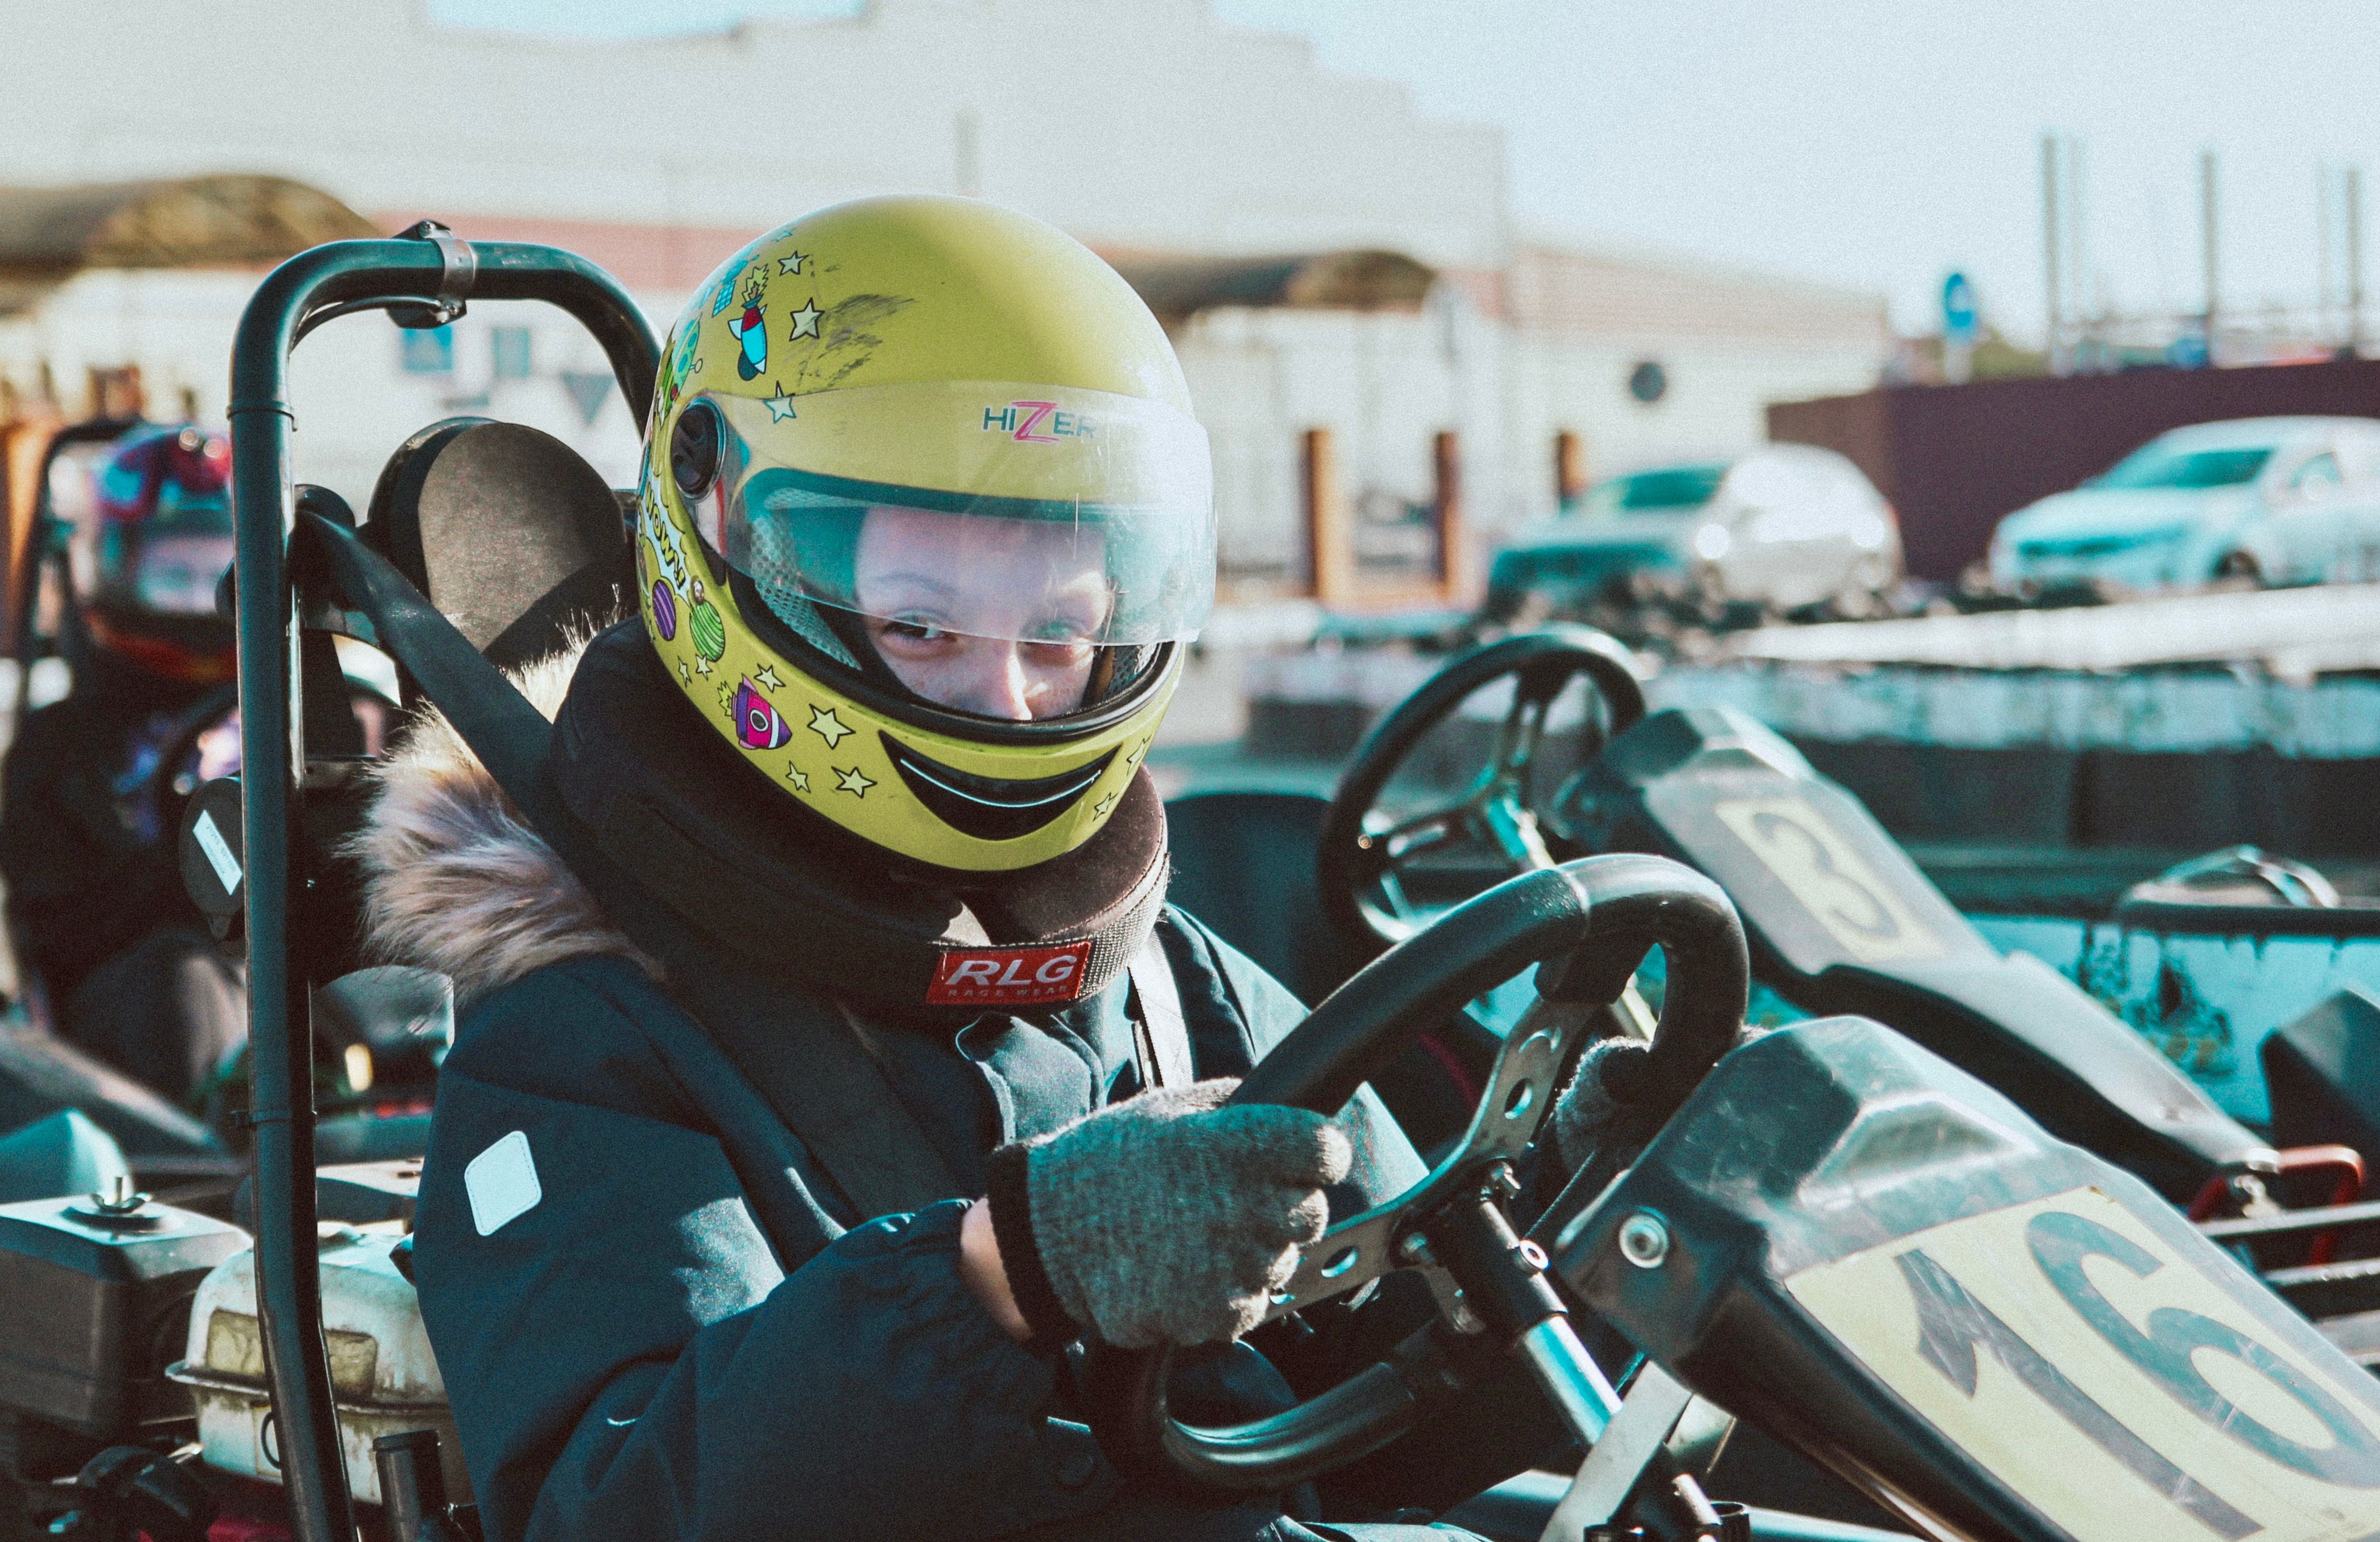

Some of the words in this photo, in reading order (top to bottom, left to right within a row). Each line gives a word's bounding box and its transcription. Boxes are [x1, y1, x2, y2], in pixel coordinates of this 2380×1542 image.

[983, 401, 1097, 443] HIZER
[1752, 812, 1900, 939] 3
[945, 955, 1078, 986] RLG
[1894, 1211, 2380, 1541] 16
